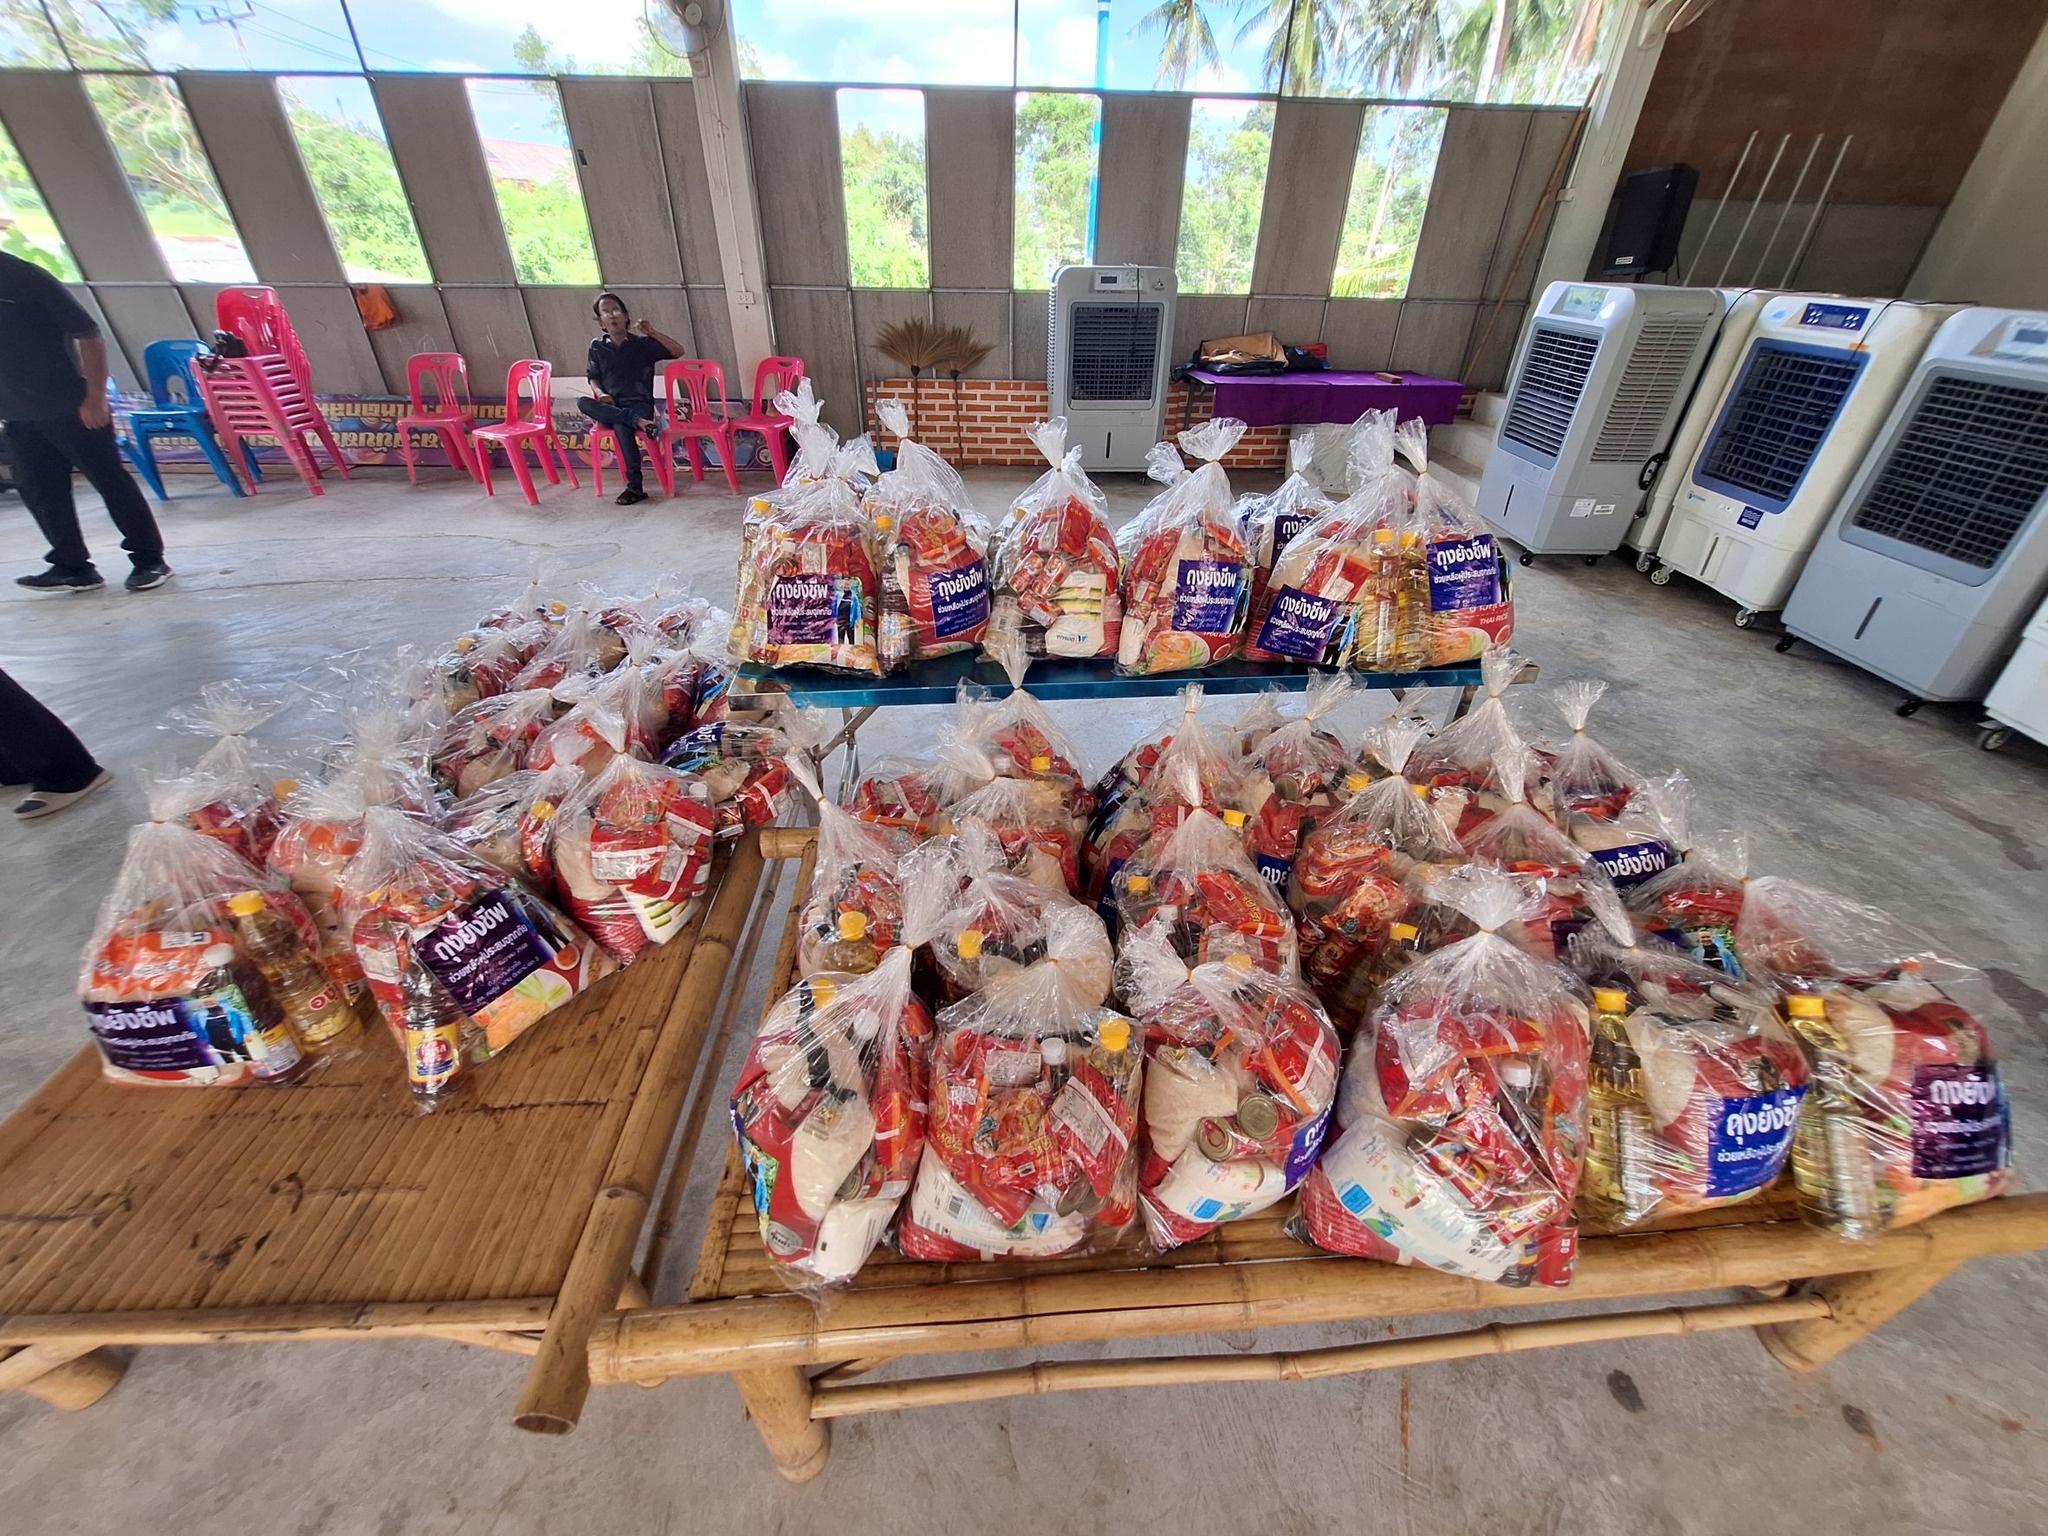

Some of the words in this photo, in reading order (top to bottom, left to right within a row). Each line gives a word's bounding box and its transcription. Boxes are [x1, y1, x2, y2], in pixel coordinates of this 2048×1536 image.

[1437, 540, 1491, 571] ถุงยังชีพ
[775, 578, 829, 605] ถุงยังชีพ
[938, 567, 983, 602] ถุงยังชีพ
[1186, 566, 1237, 592] ถุงยังชีพ
[1280, 595, 1331, 622] ถุงยังชีพ
[434, 901, 509, 963] ถุงยังชีพ
[448, 924, 528, 984] ช่วยเหลือผู้ประสบอุทกภัย
[1726, 1096, 1798, 1146] ถุงยังชี
